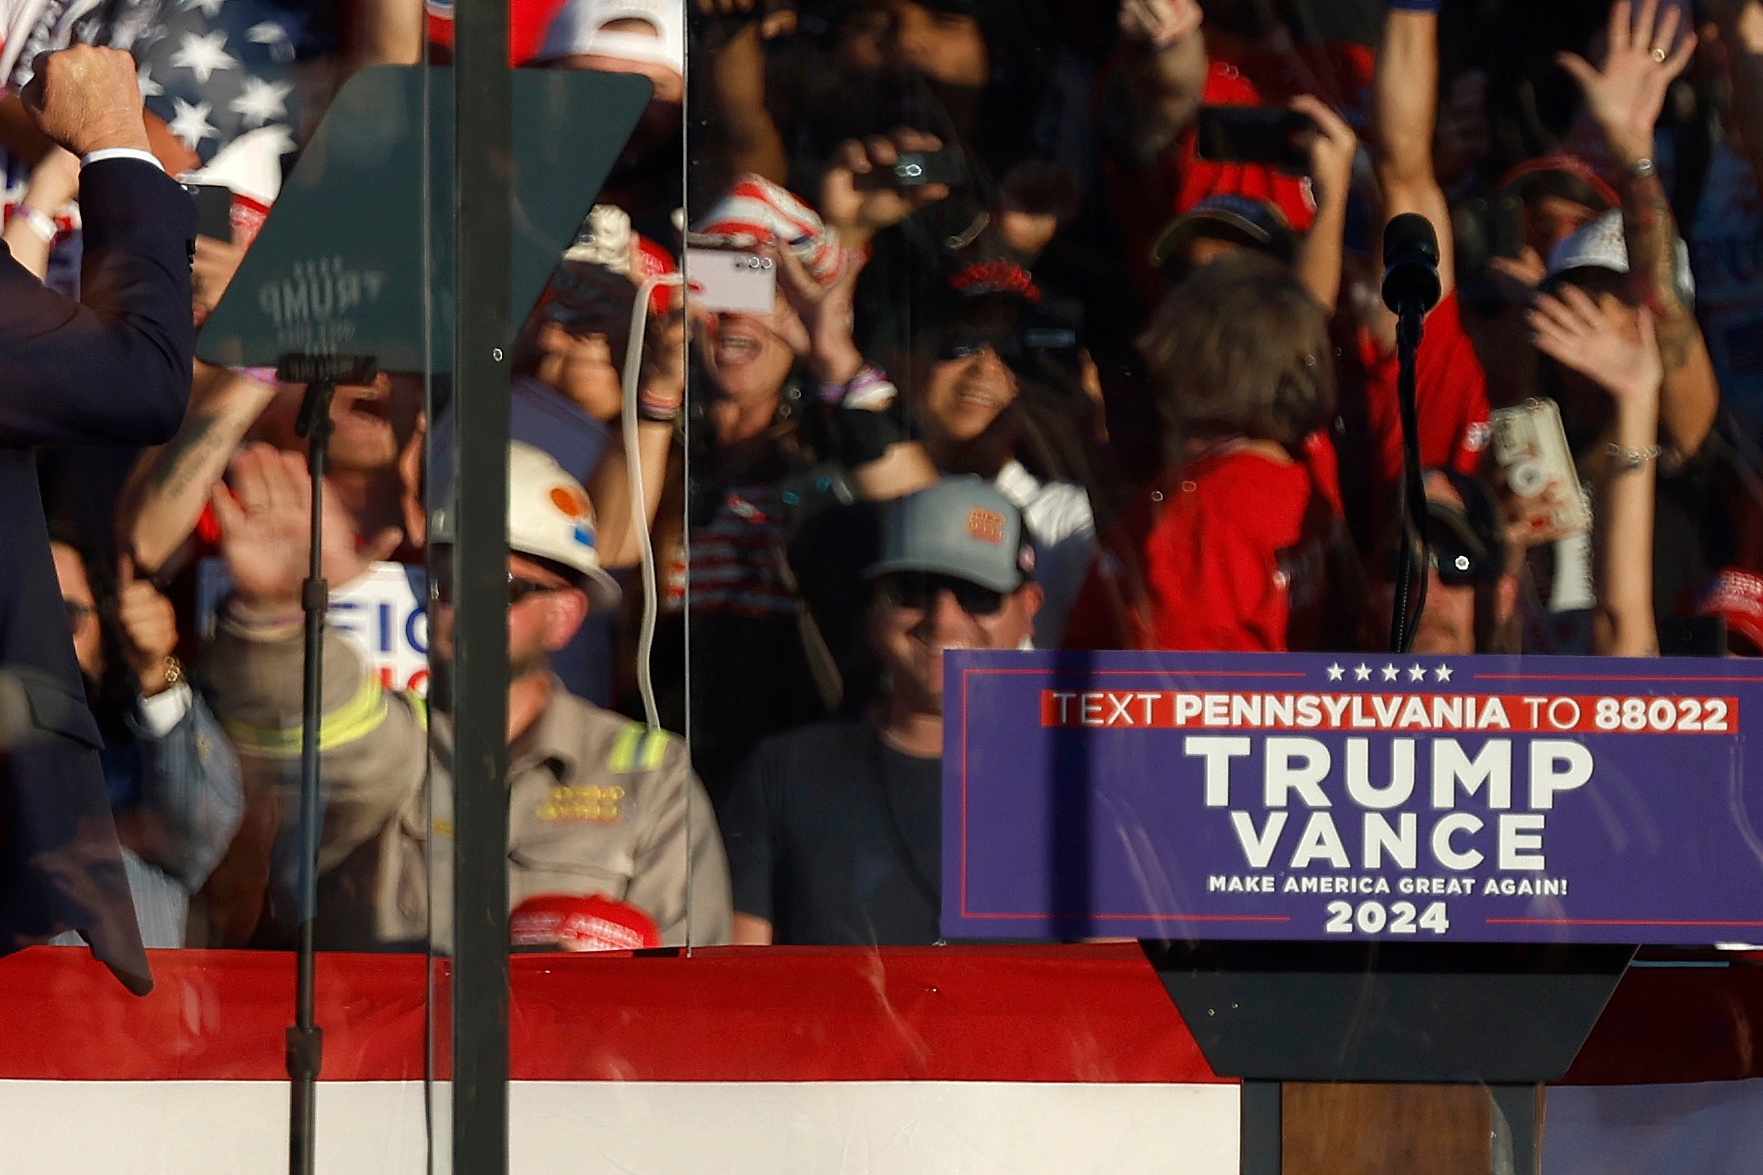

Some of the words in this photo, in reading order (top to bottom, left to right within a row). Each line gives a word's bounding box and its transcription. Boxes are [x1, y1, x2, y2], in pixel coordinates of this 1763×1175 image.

[1053, 693, 1162, 725] TEXT
[1175, 693, 1510, 729] PENNSYLVANIA
[1523, 697, 1581, 729] TO
[1595, 697, 1729, 731] 88022
[1185, 736, 1595, 810] TRUMP
[1230, 810, 1546, 870] VANCE
[1208, 875, 1276, 893] MAKE
[1283, 876, 1391, 894] AMERICA
[1398, 877, 1477, 895] GREAT
[1484, 878, 1569, 896] AGAIN!
[1324, 900, 1450, 934] 2024
